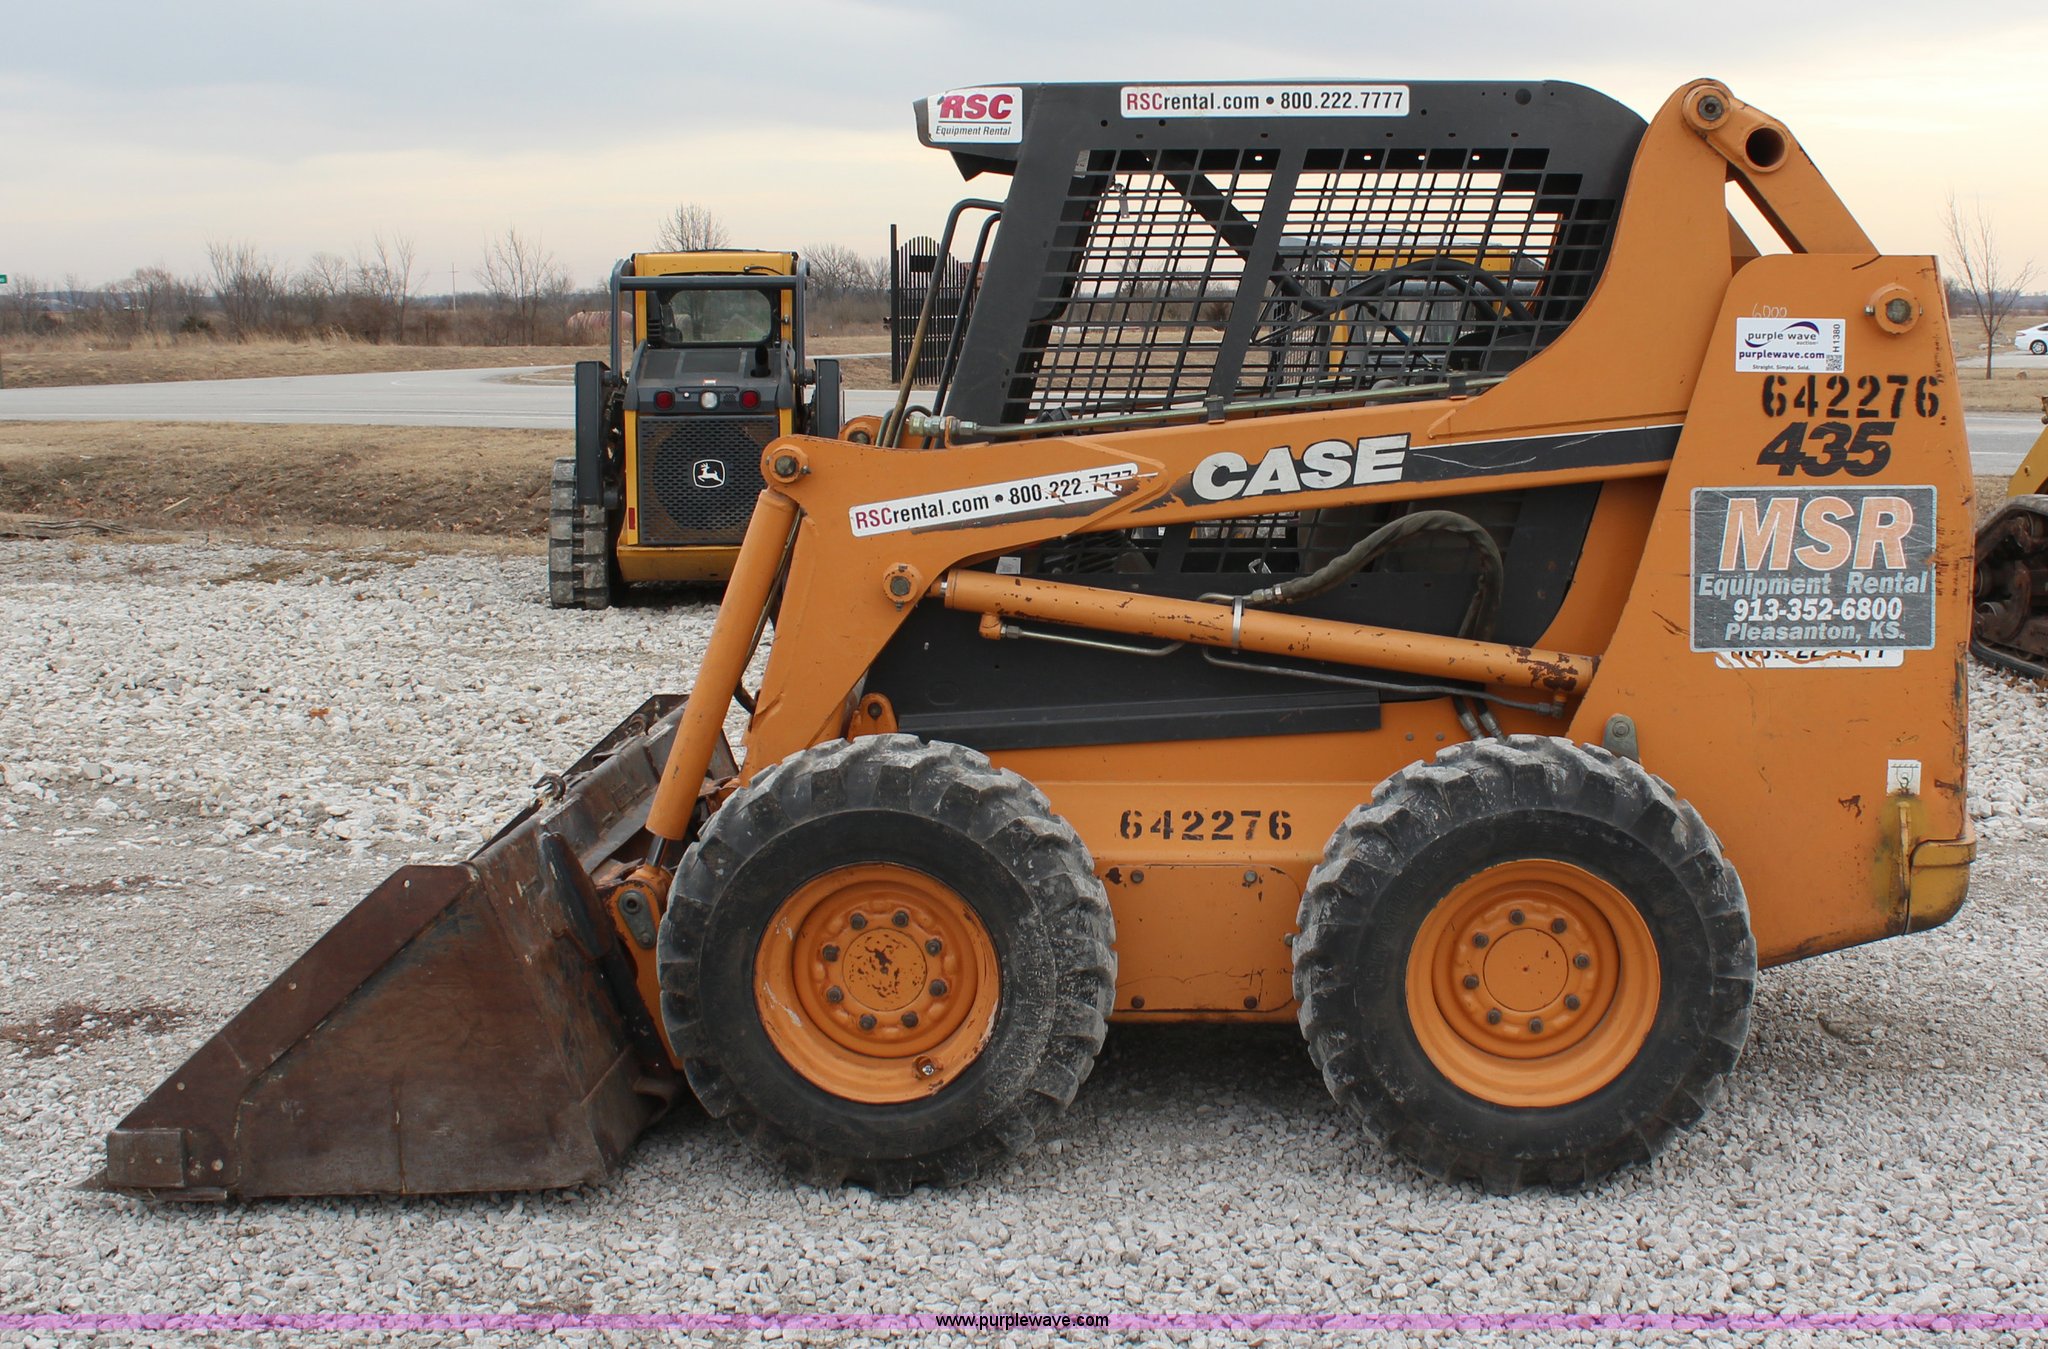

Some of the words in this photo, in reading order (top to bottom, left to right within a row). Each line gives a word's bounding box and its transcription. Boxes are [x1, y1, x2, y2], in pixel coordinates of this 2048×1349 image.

[939, 94, 1013, 120] RSC
[1126, 93, 1260, 111] RSCrental.com
[1280, 91, 1404, 110] 800.222.7777
[935, 125, 981, 136] Equipment
[982, 126, 1012, 136] Rental
[1748, 331, 1783, 340] purple
[1788, 333, 1817, 341] wave
[1739, 349, 1825, 360] purplewave.com
[1762, 375, 1939, 418] 642276
[1757, 422, 1896, 477] 435
[1192, 435, 1409, 500] CASE
[855, 497, 990, 530] RSCrental.com
[1718, 496, 1914, 571] MSR
[1699, 573, 1832, 600] Equipment
[1846, 571, 1928, 594] Rental
[1733, 597, 1903, 622] 913-352-6800
[1724, 622, 1861, 642] Pleasanton,
[1120, 810, 1292, 841] 642276
